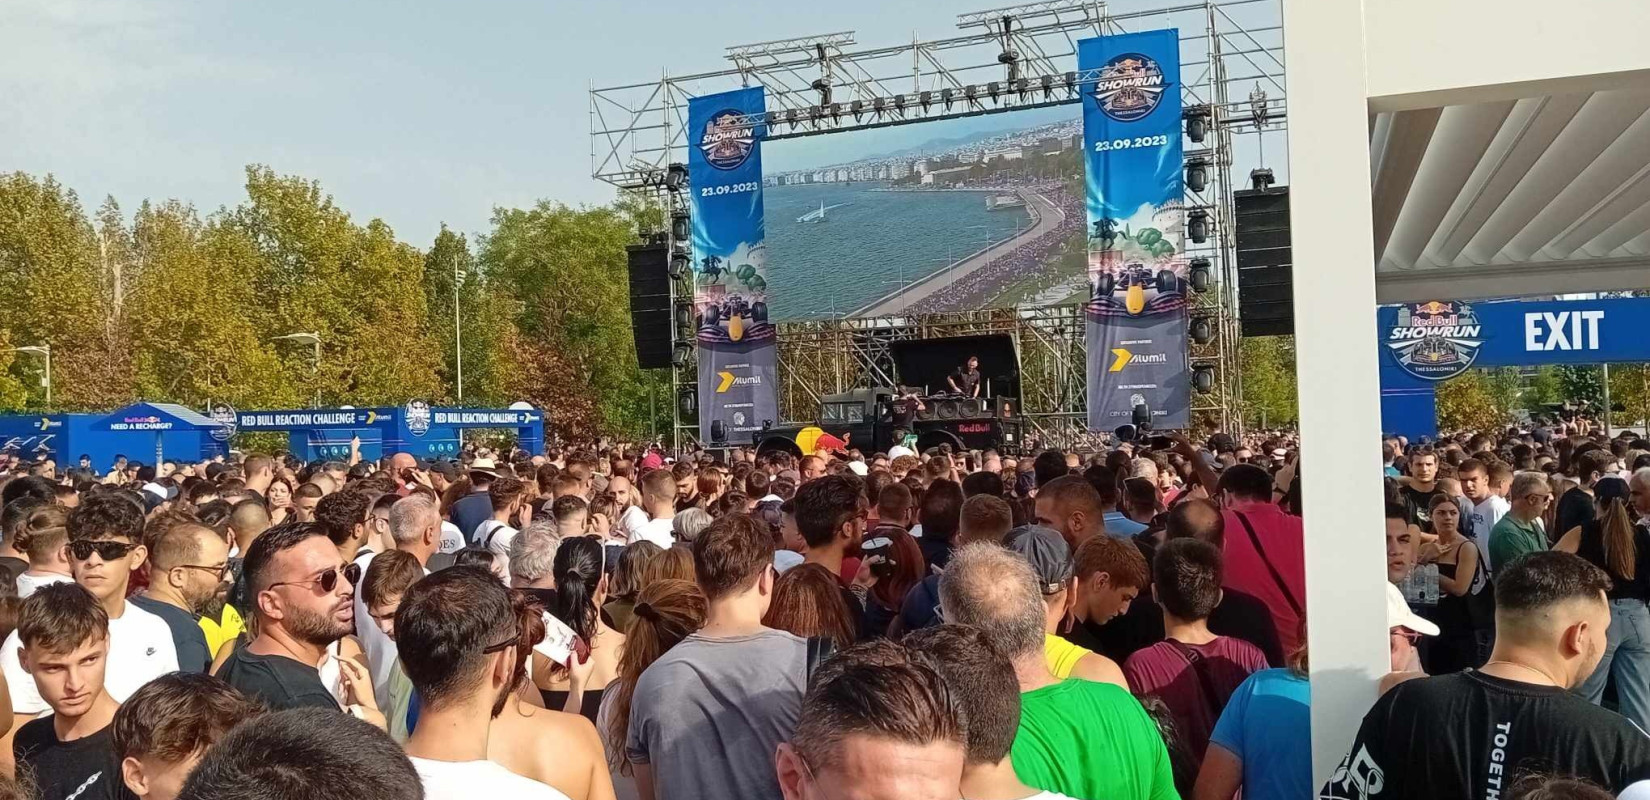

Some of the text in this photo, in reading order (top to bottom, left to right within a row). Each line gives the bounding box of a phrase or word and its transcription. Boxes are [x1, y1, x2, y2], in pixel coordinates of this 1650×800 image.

[1096, 76, 1162, 91] SHOWRUN
[702, 128, 753, 144] SHOWRUN
[1095, 135, 1168, 152] 23.09.2023
[702, 182, 758, 196] 23.09.2023
[1412, 315, 1458, 326] Red Bull
[1390, 326, 1481, 339] SHOWRUN
[1525, 310, 1605, 351] EXIT
[241, 415, 256, 426] RED
[257, 415, 274, 426] BULL
[275, 414, 311, 425] REACTION
[313, 412, 356, 425] CHALLENGE
[434, 412, 447, 423] RED
[448, 412, 461, 423] BULL
[462, 412, 489, 423] REACTION
[490, 412, 518, 423] CHALLENGE
[135, 422, 173, 430] RECHARGE?
[959, 424, 990, 432] Red Bull
